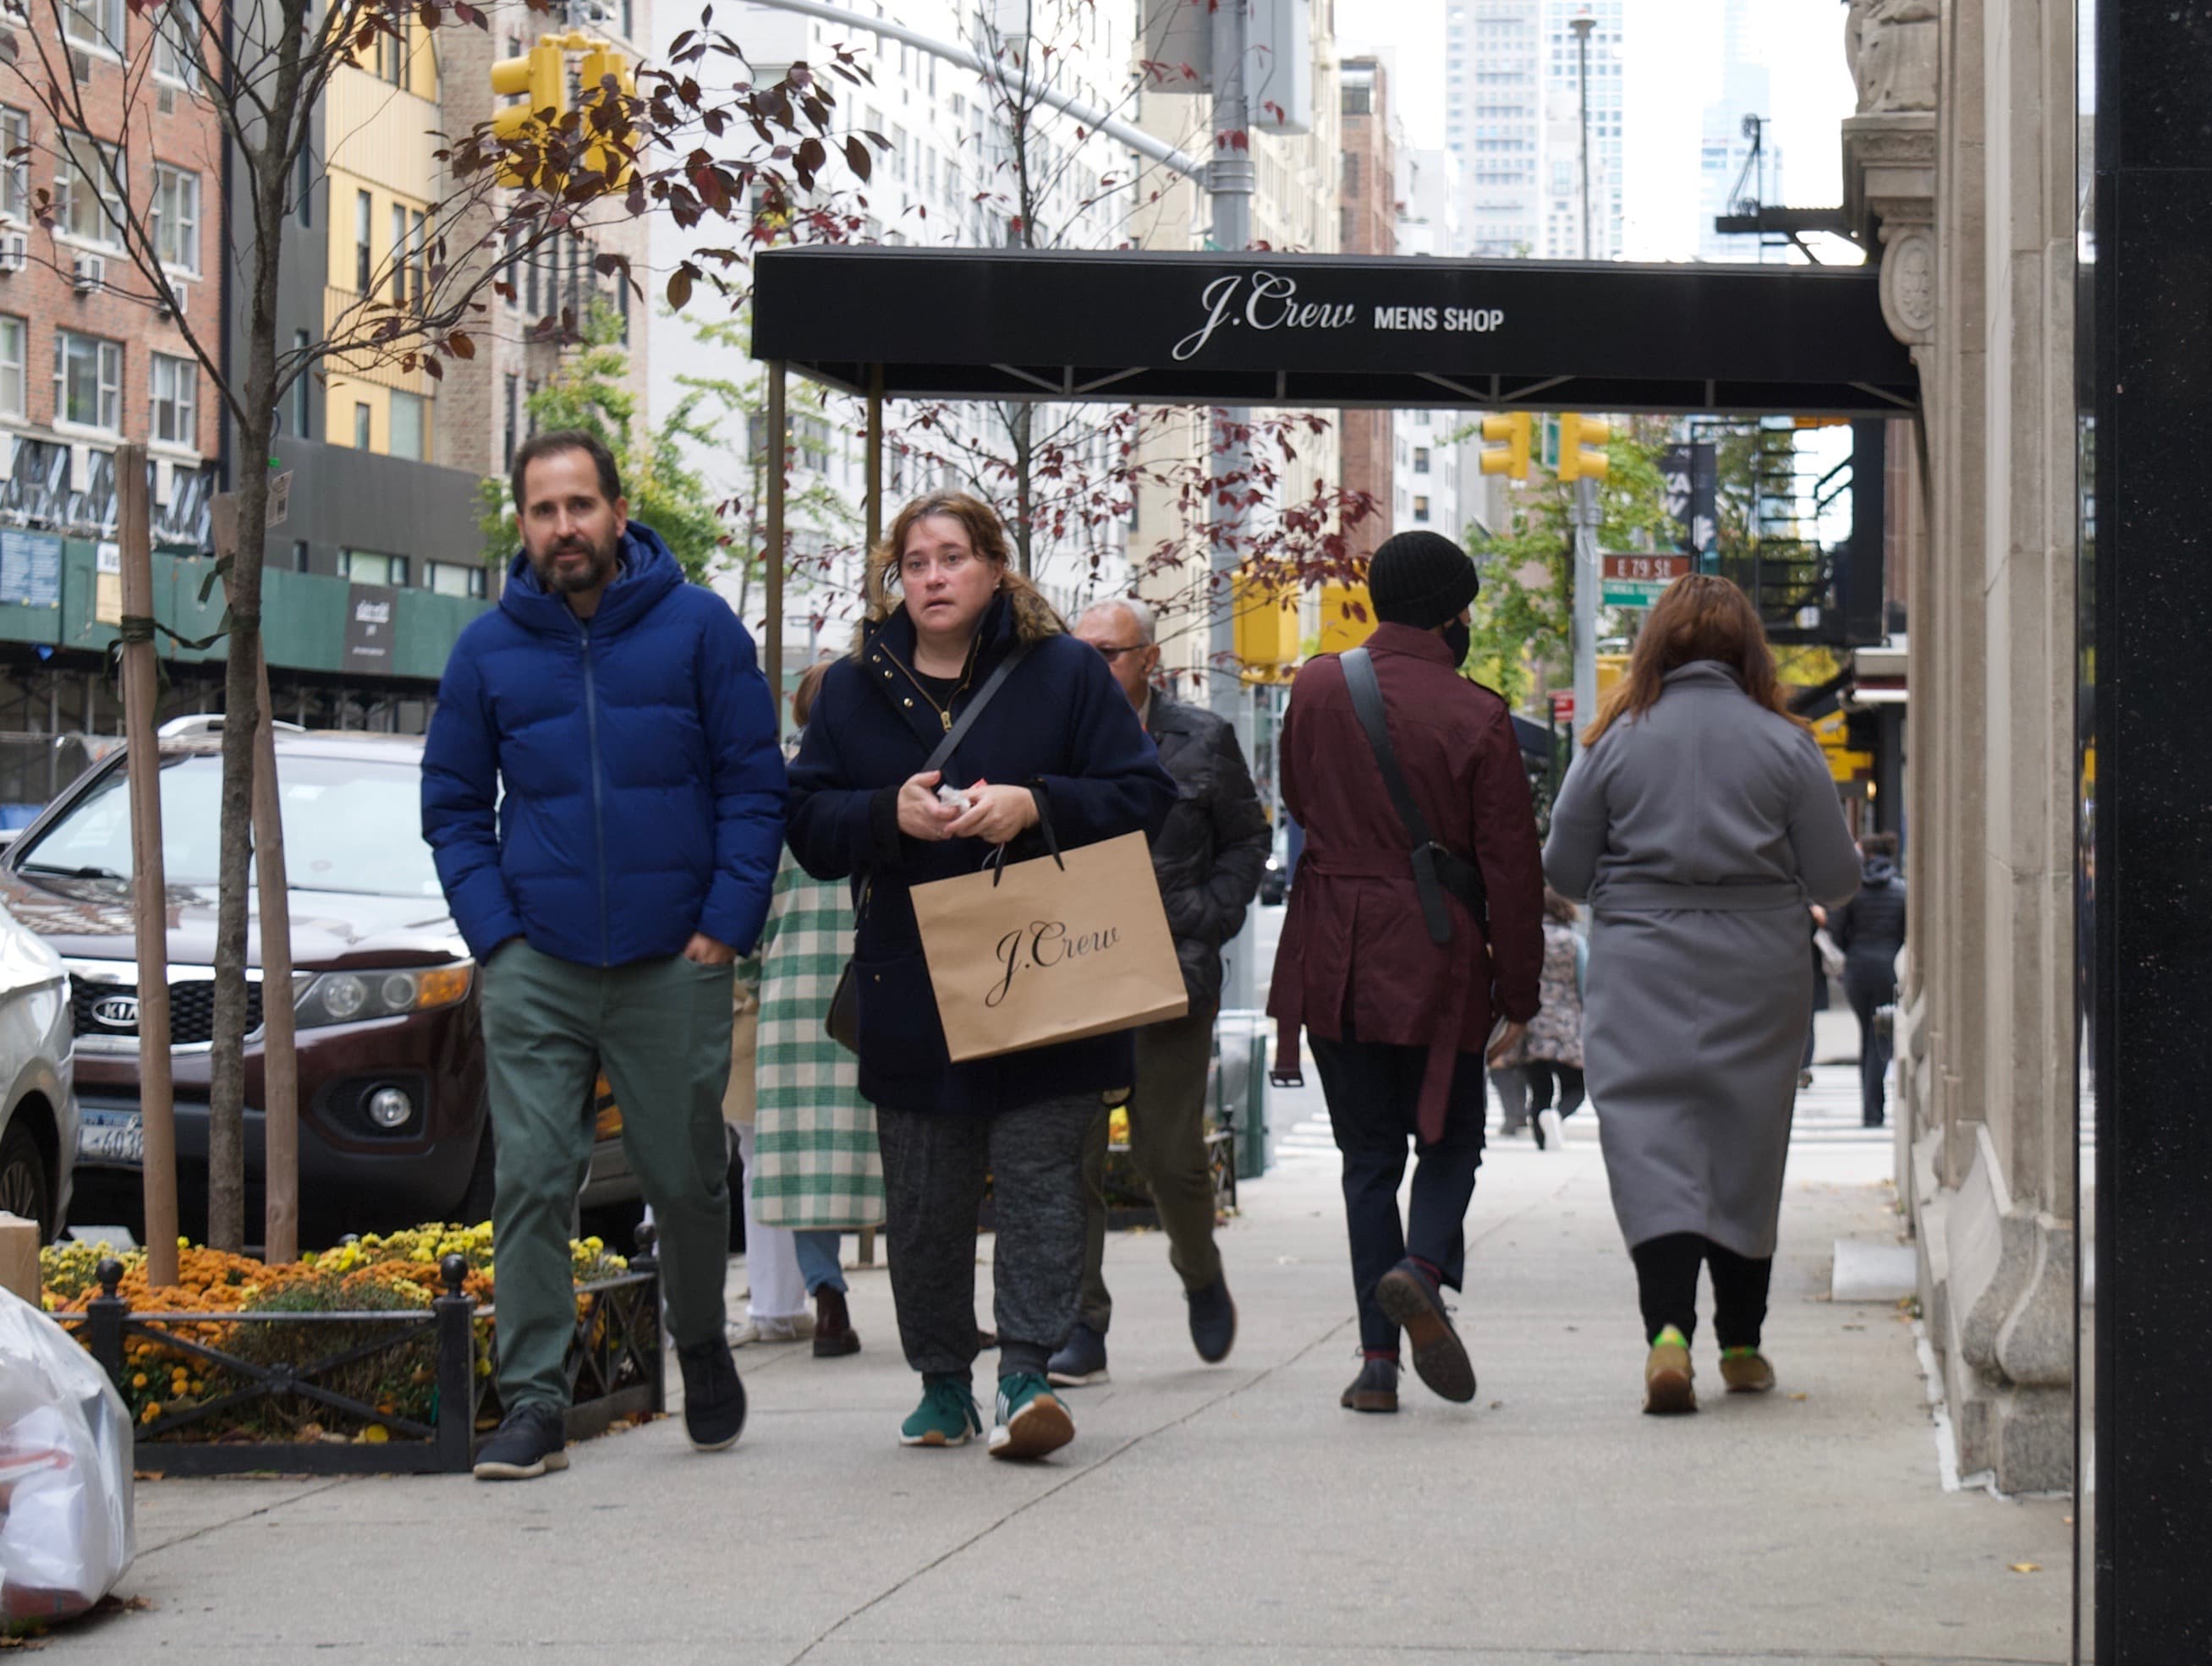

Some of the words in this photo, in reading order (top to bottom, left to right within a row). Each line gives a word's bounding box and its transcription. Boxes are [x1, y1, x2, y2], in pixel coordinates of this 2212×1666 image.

[1172, 270, 1356, 361] J.Crew
[1374, 306, 1437, 332] MENS
[1443, 308, 1504, 332] SHOP
[1630, 559, 1651, 577] 79
[985, 920, 1122, 1008] J.Crew
[104, 1003, 140, 1020] KIA
